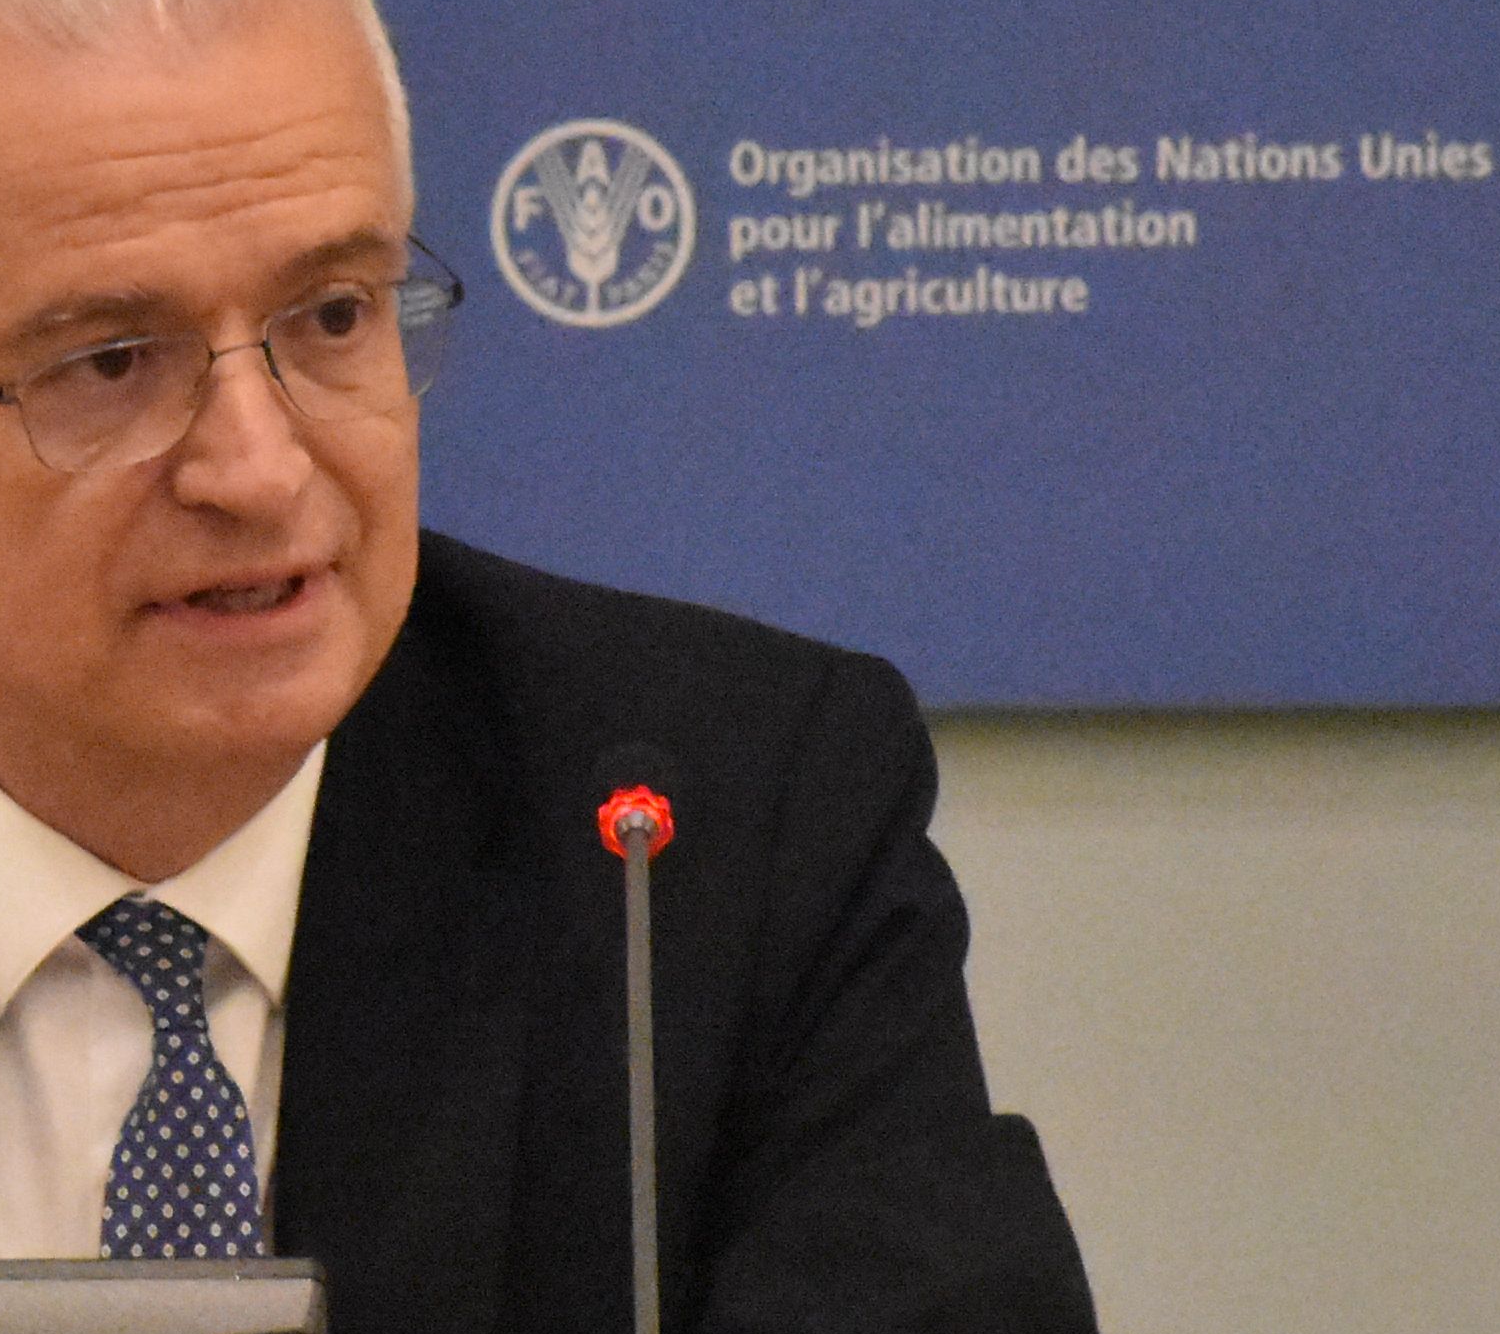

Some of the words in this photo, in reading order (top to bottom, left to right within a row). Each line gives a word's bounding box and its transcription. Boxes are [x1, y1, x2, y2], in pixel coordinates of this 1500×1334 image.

[729, 138, 1040, 196] Organisation
[1056, 135, 1139, 182] des
[1156, 134, 1343, 181] Nations
[1359, 133, 1493, 179] Unies
[728, 214, 840, 260] pour
[857, 201, 1197, 250] l'alimentation
[729, 274, 778, 315] et
[794, 267, 1089, 327] l'agriculture
